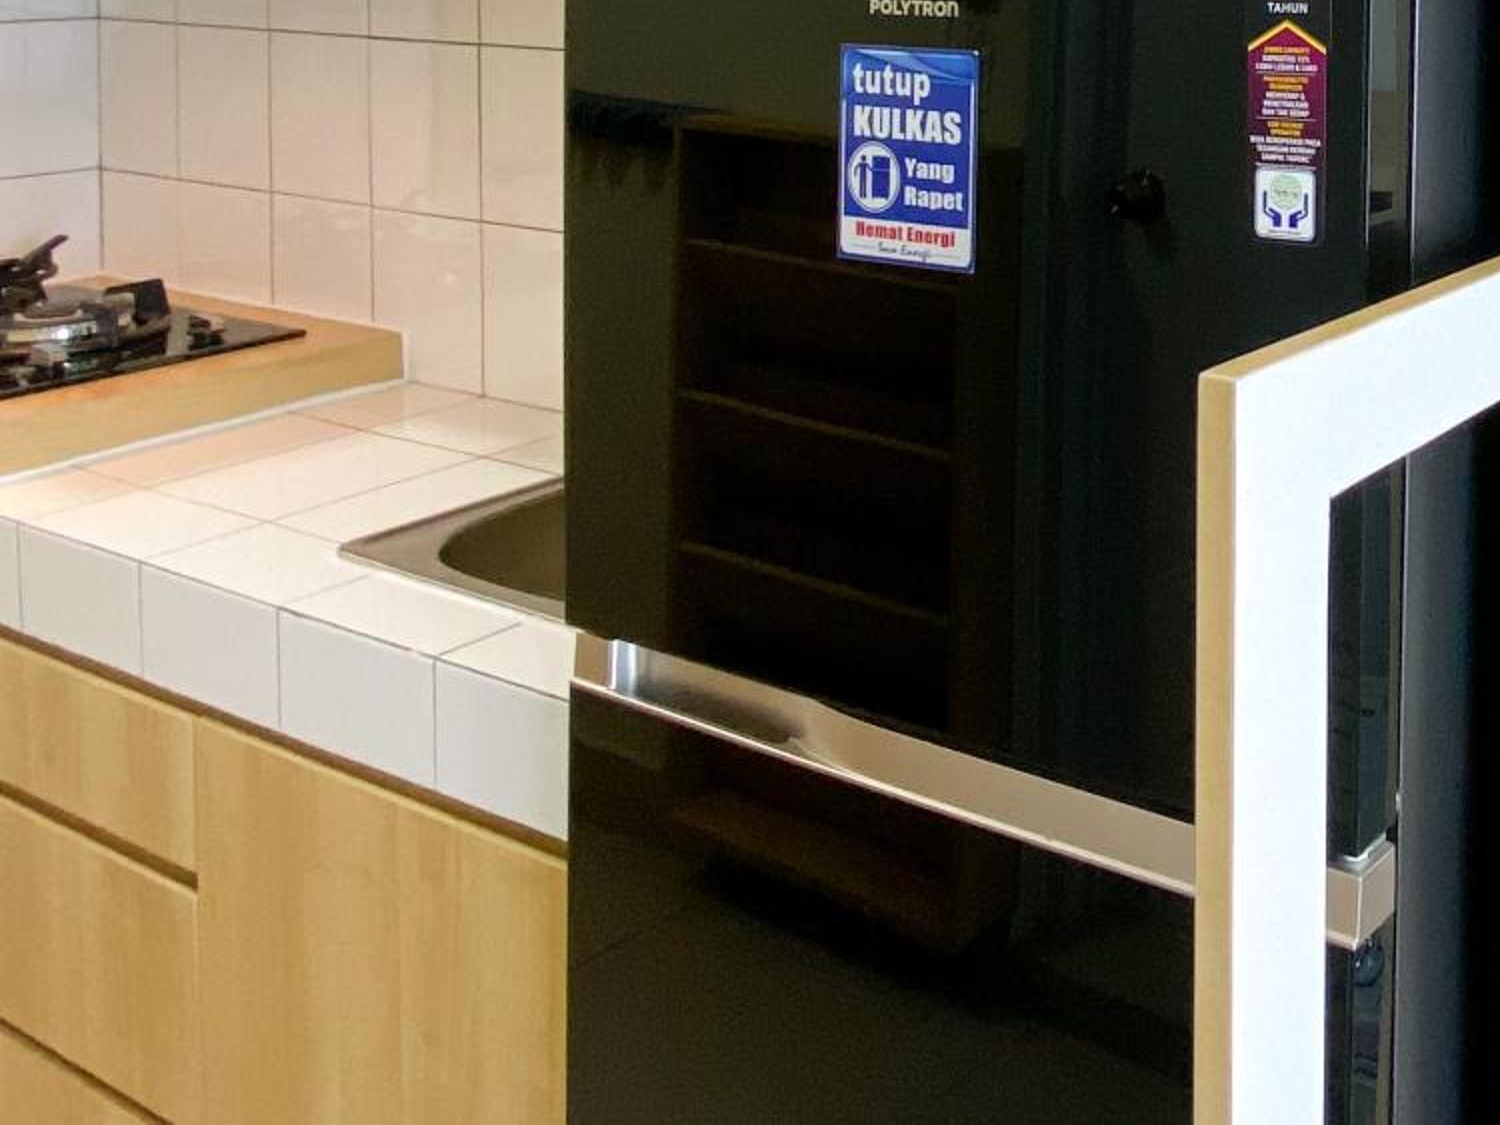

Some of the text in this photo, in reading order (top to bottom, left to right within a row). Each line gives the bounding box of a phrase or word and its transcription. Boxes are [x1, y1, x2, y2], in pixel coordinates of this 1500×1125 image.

[1267, 2, 1309, 14] TAHUN
[852, 62, 931, 106] tutup
[853, 104, 962, 145] KULKAS
[904, 157, 955, 184] Yang
[904, 185, 963, 211] Rapet
[856, 221, 956, 248] Hemat Energi
